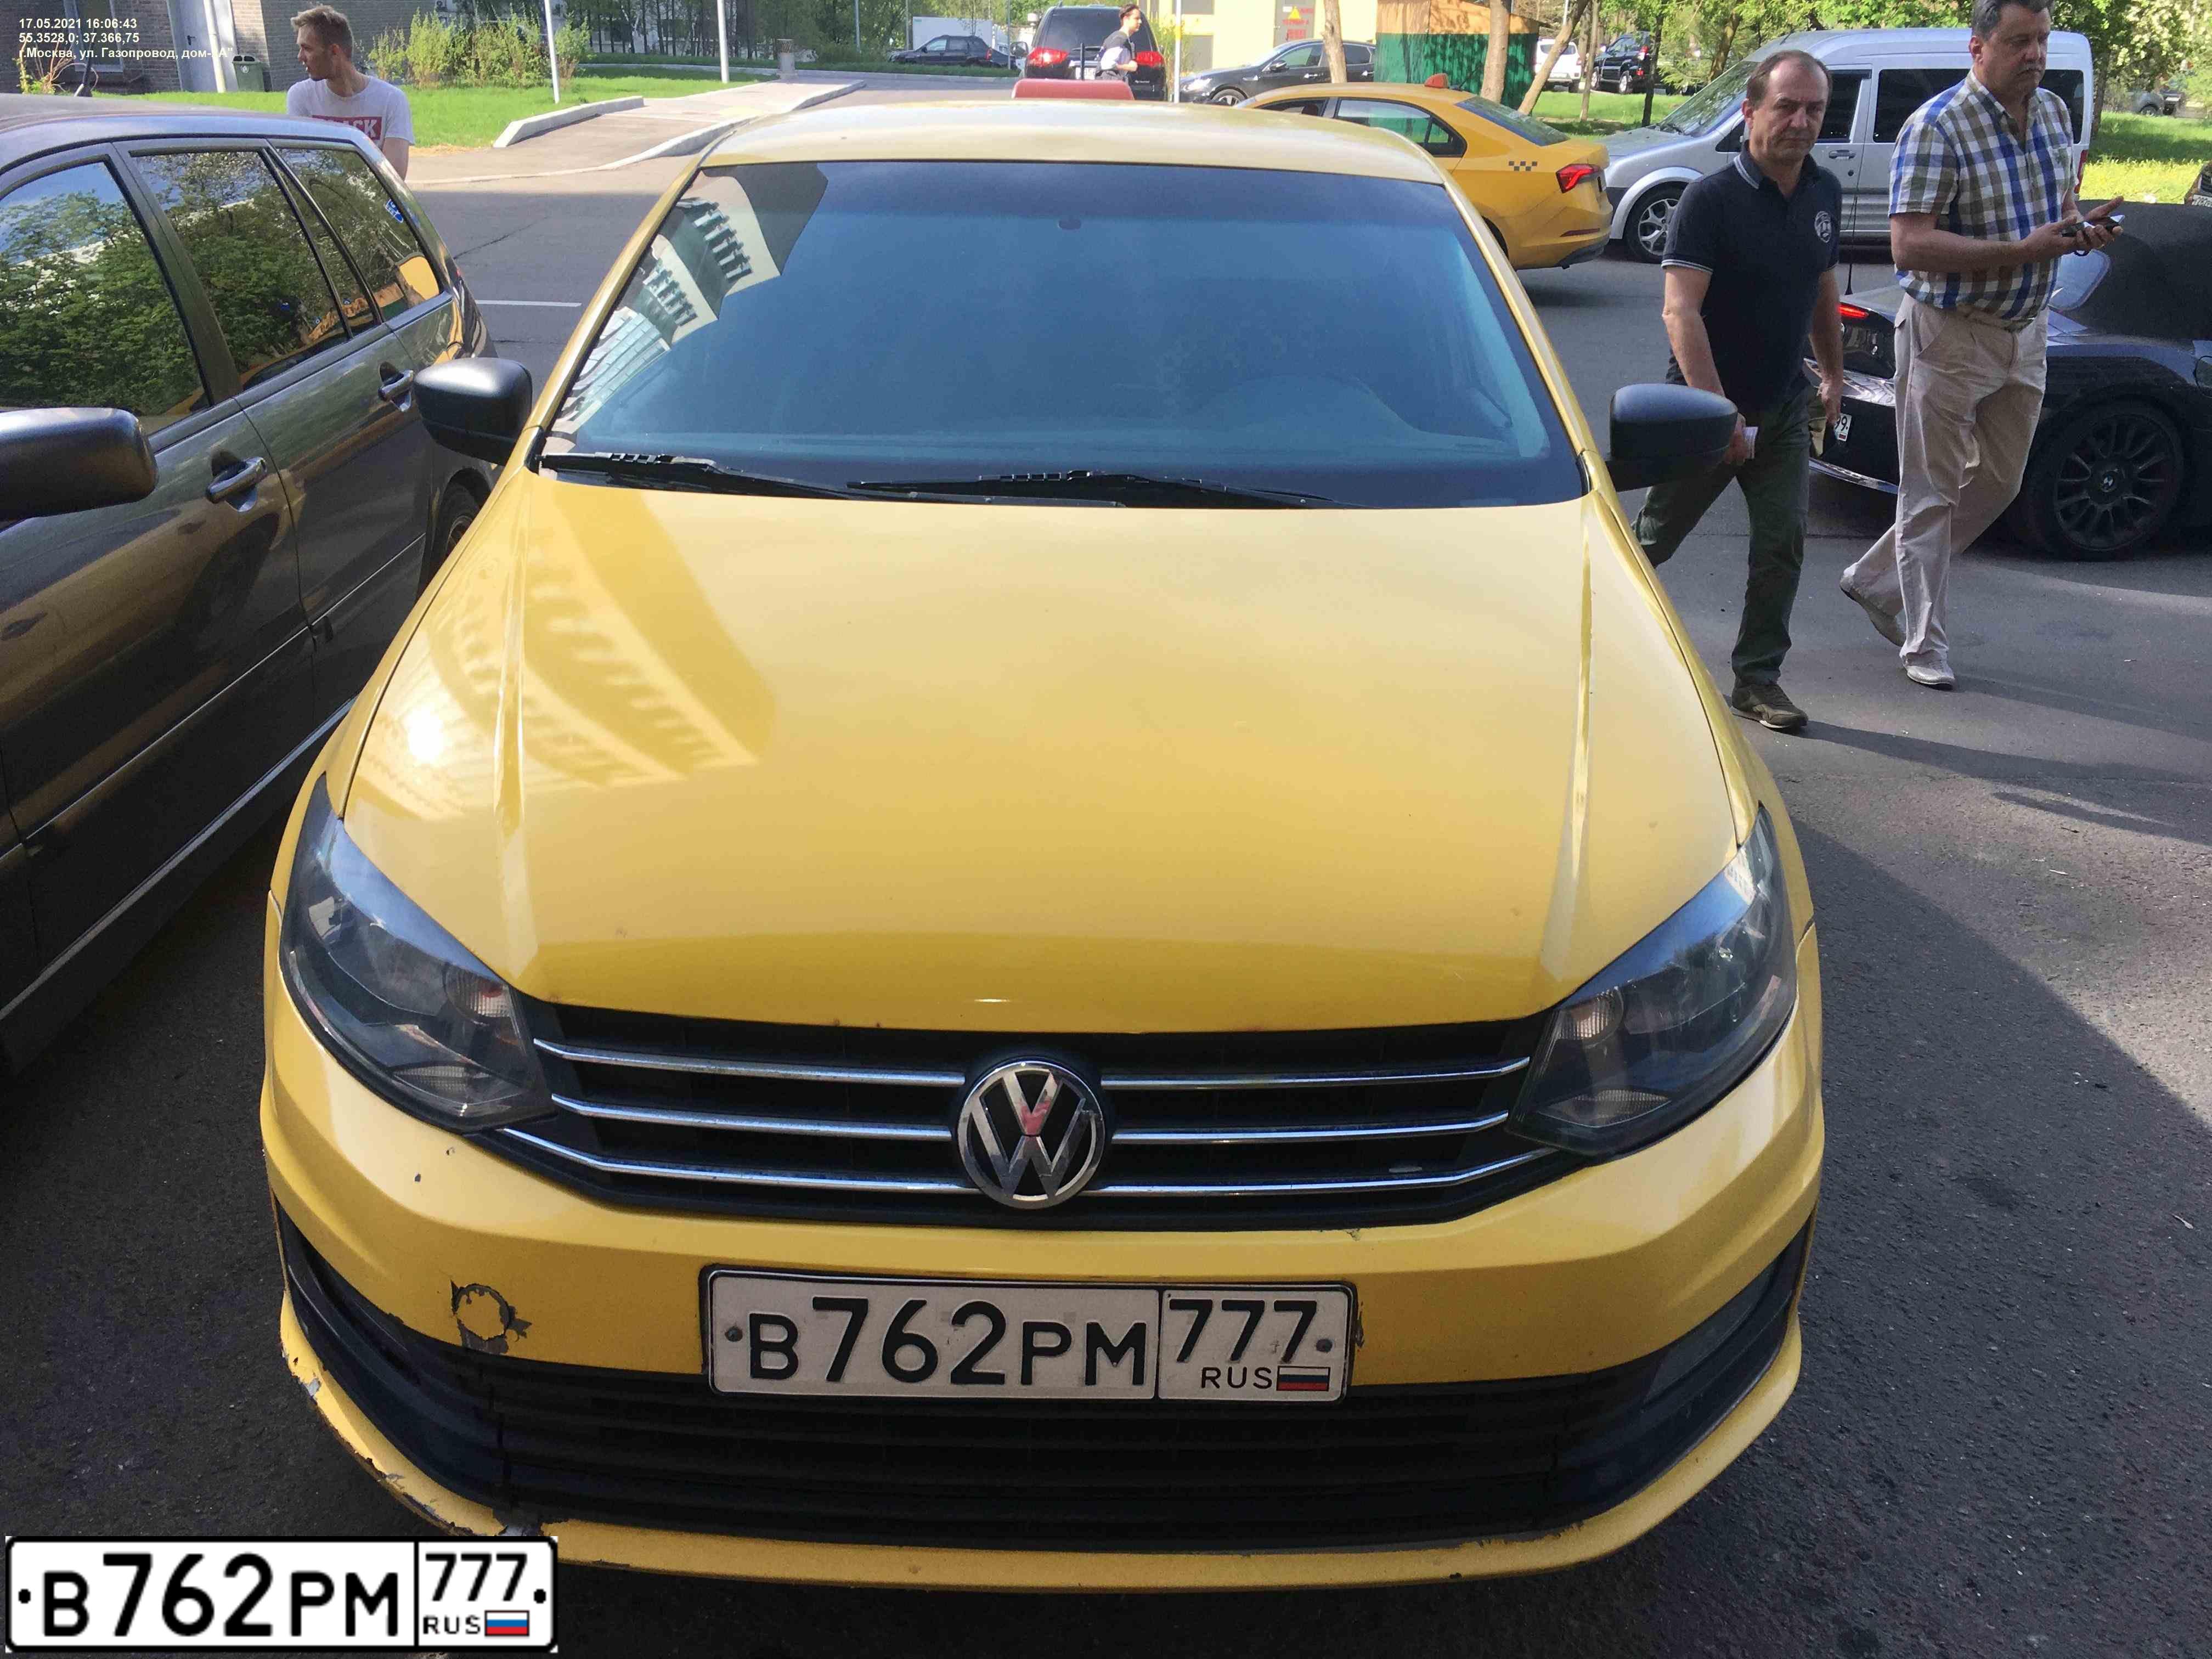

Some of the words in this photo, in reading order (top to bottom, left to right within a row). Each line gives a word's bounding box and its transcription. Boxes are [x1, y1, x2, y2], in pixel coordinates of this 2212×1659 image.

[748, 1296, 1147, 1387] В762РМ
[1169, 1299, 1318, 1365] 777
[1200, 1366, 1273, 1390] RUS
